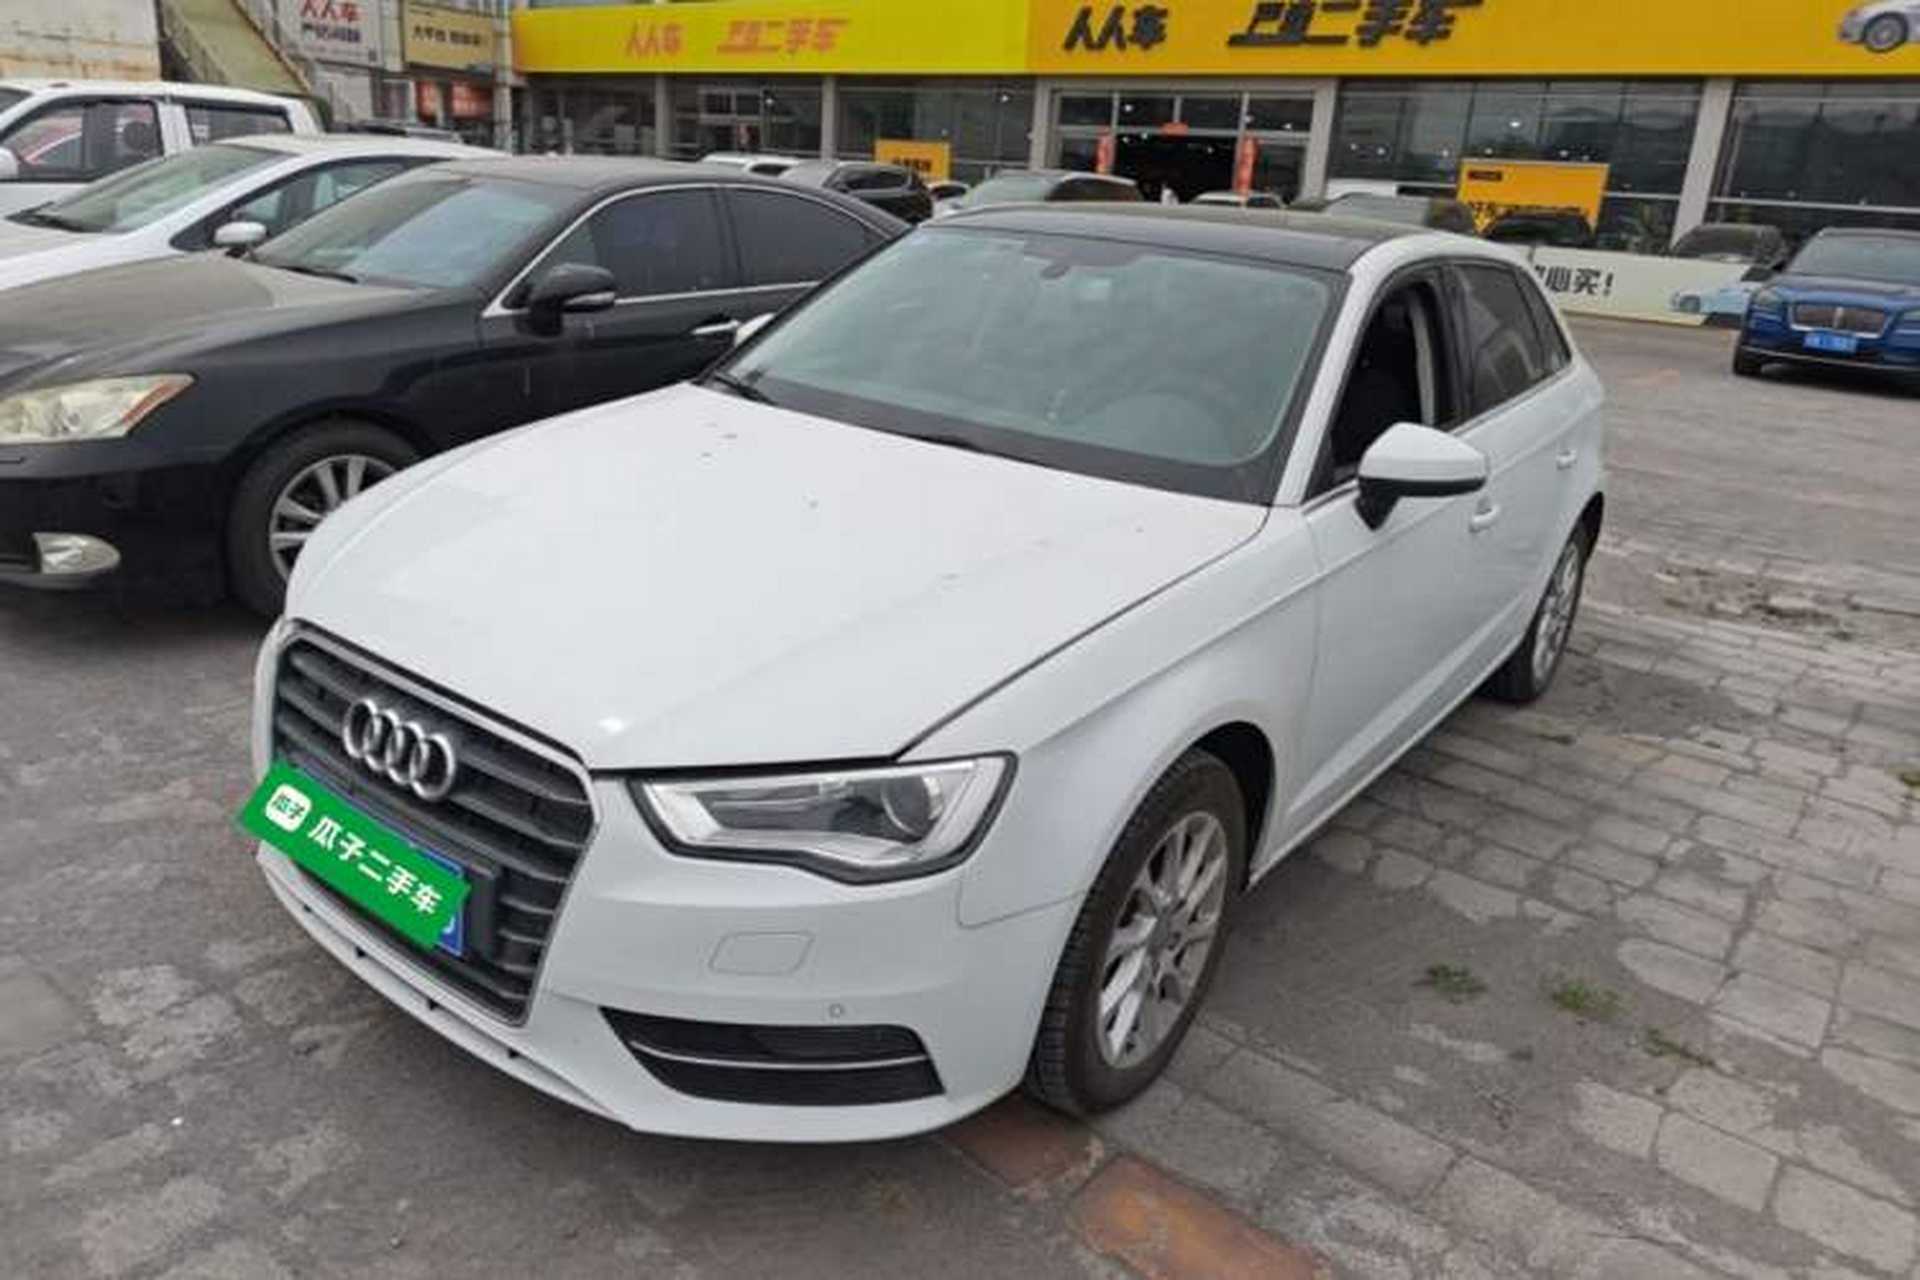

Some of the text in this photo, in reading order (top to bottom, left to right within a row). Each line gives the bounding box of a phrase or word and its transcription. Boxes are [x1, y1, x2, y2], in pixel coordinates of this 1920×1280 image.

[624, 20, 685, 57] 人人车
[1063, 4, 1169, 51] 人人车
